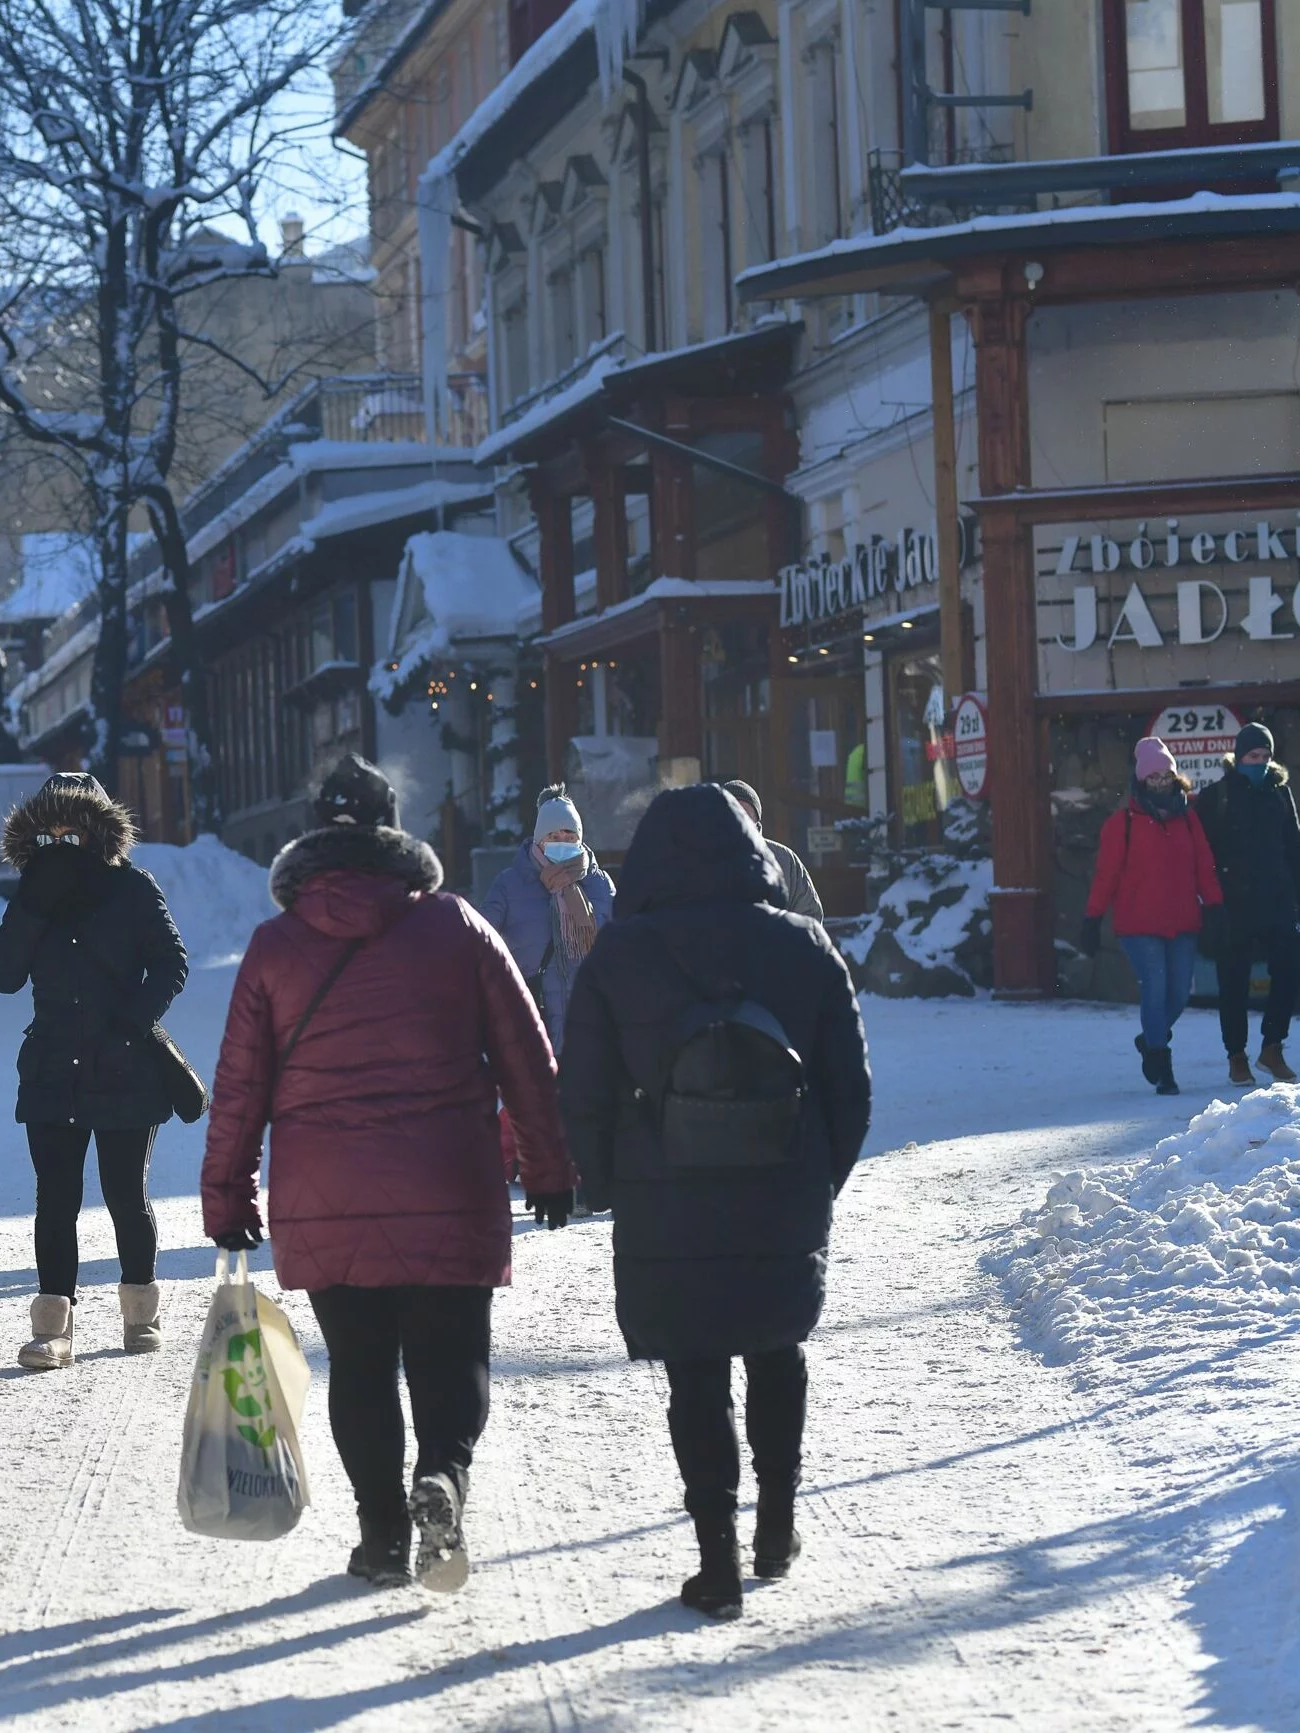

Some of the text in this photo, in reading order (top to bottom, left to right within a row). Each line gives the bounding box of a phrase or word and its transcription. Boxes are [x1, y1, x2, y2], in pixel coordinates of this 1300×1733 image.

[1056, 512, 1300, 575] Zbójeck
[1056, 576, 1300, 651] JADŁ
[1167, 711, 1198, 733] 29
